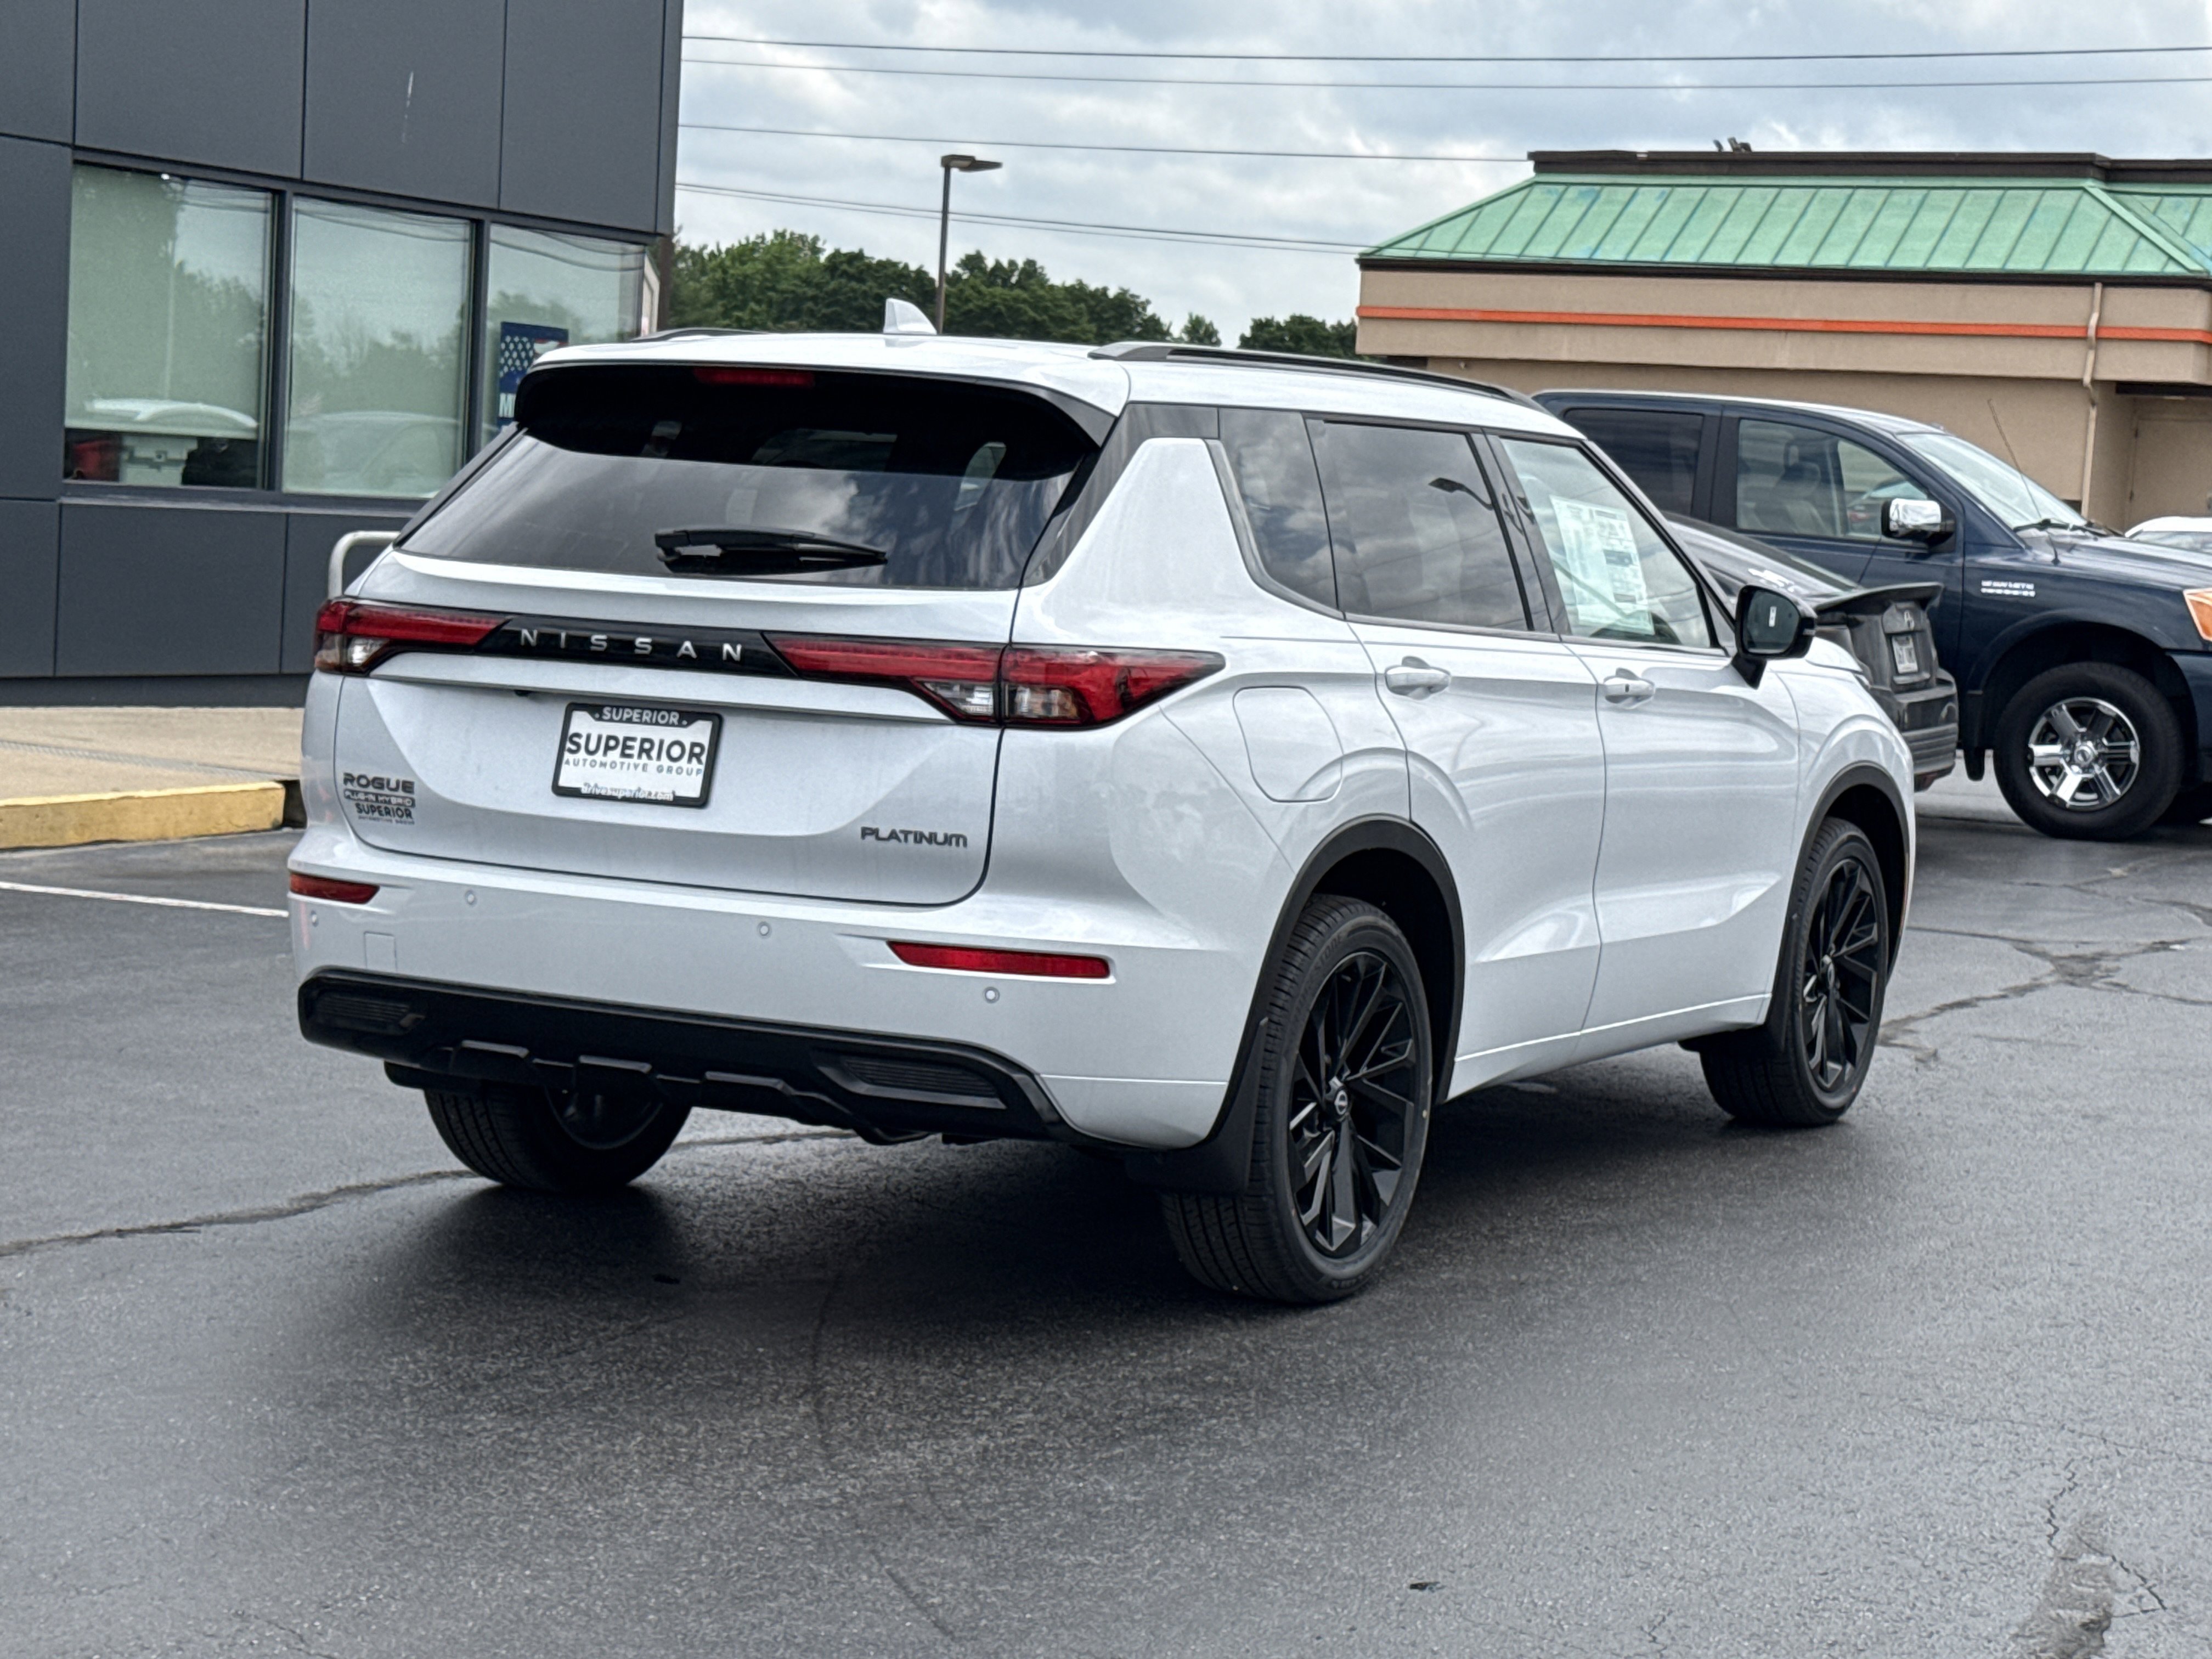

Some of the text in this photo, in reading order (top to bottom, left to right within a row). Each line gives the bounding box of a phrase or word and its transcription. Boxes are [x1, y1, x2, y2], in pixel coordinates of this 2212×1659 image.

[520, 628, 742, 662] NISSAN
[602, 706, 680, 725] SUPERIOR
[566, 732, 706, 765] SUPERIOR
[564, 758, 703, 776] AUTOMOTIVE GROUP
[343, 772, 415, 794] ROGUE
[355, 803, 413, 820] SUPERIOR
[860, 826, 968, 848] PLATINUM
